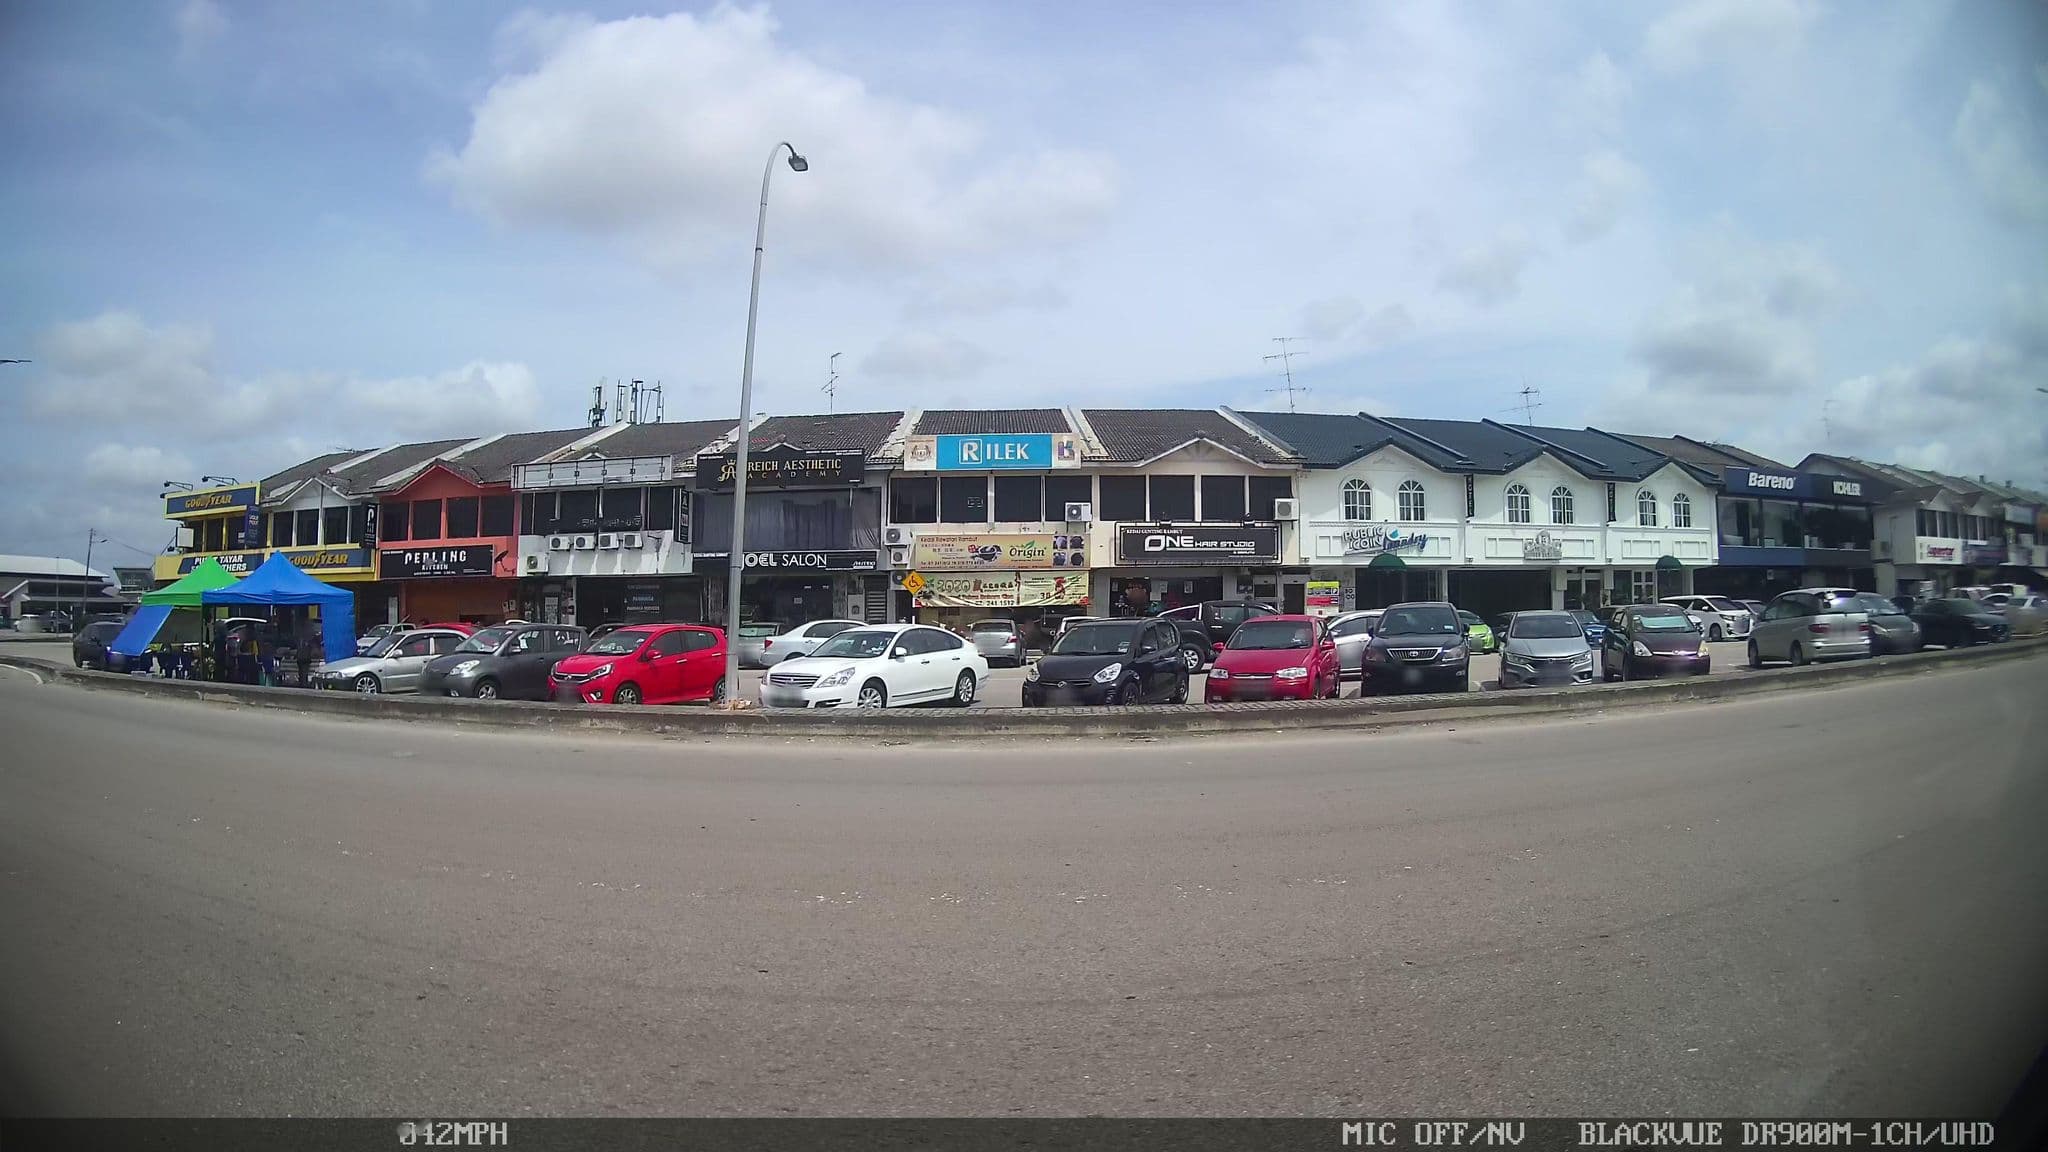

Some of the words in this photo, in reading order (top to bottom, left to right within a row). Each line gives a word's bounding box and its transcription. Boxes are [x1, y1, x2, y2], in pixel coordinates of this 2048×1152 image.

[962, 441, 1030, 461] RILEK
[748, 460, 778, 472] REICH
[783, 459, 842, 471] AESTHETIC
[747, 471, 841, 479] ACADEMY
[1748, 472, 1795, 490] Bareno
[1833, 481, 1861, 496] KOHLER
[1343, 526, 1384, 541] PUBLIC
[1144, 535, 1194, 552] ONE
[1195, 540, 1218, 548] HAIR
[1219, 540, 1256, 548] STUDIO
[219, 555, 243, 564] TAYAR
[781, 553, 827, 567] SALON
[1009, 547, 1045, 559] Origin
